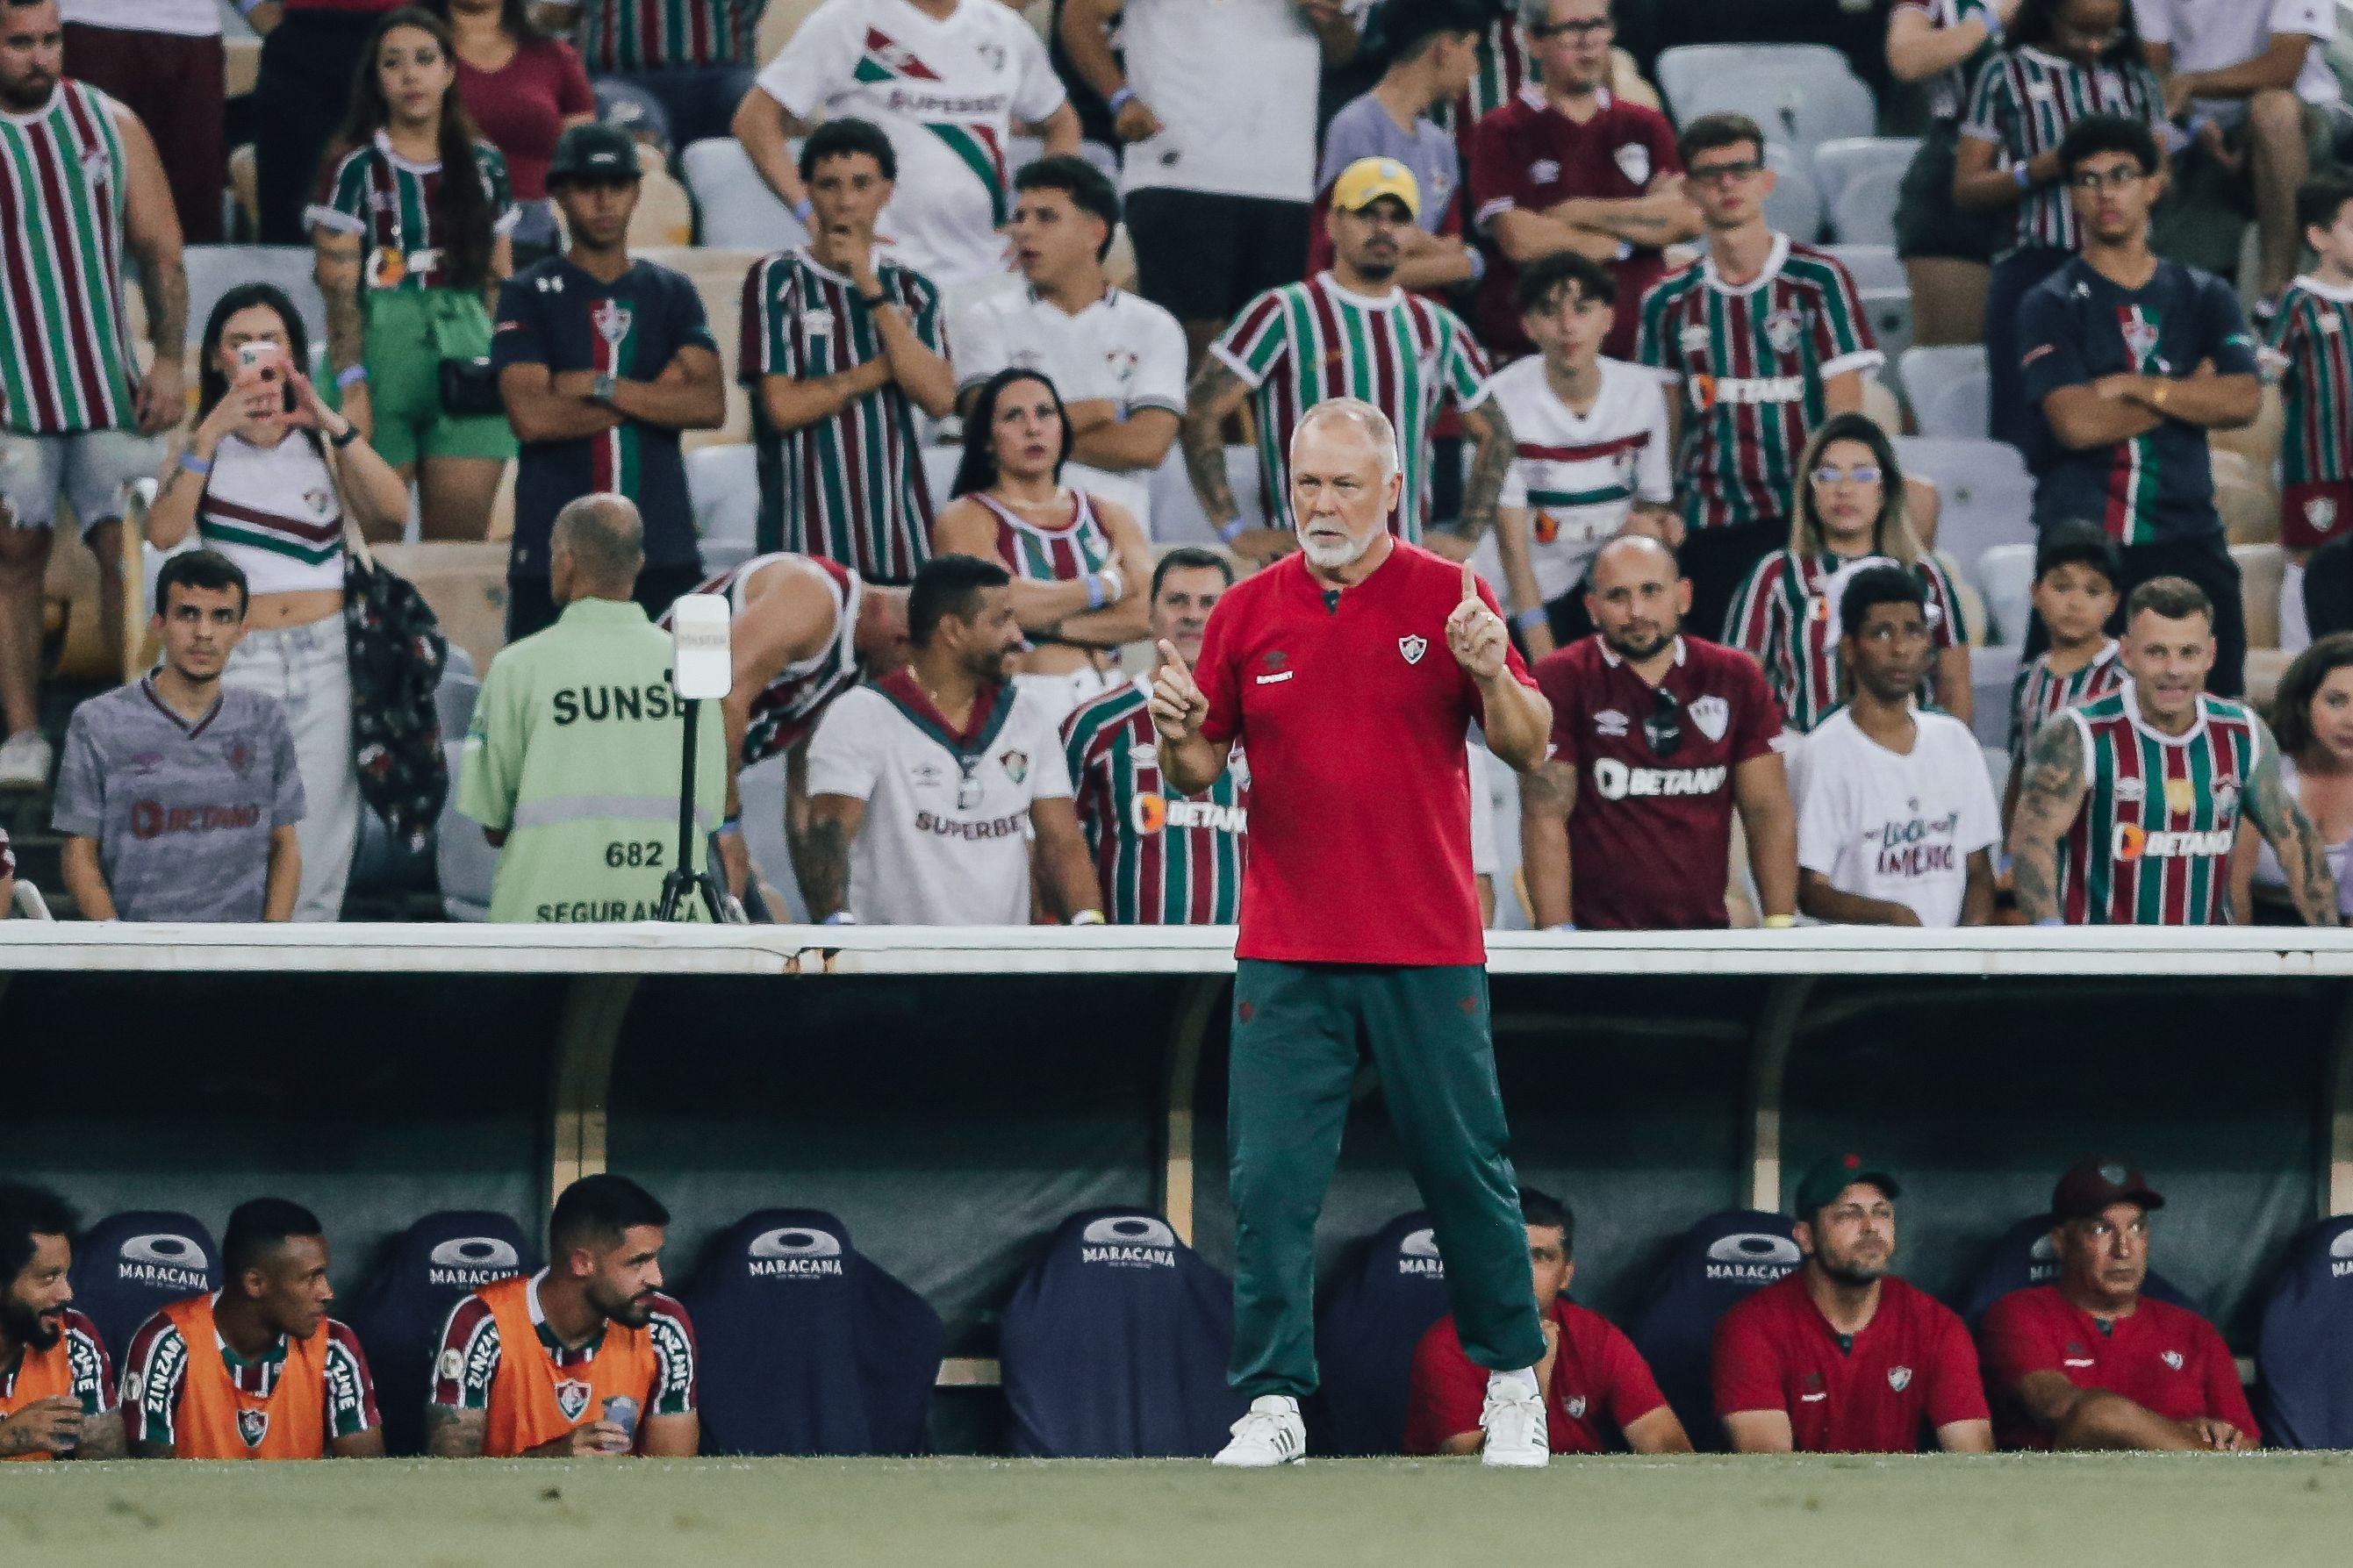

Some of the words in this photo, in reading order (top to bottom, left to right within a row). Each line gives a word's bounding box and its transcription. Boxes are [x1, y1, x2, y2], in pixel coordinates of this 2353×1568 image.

[915, 812, 1020, 841] SUPERBE
[606, 840, 664, 868] 682
[536, 899, 699, 921] SEGURANA
[1399, 1258, 1445, 1274] MARA
[147, 1335, 185, 1414] ZINZAN
